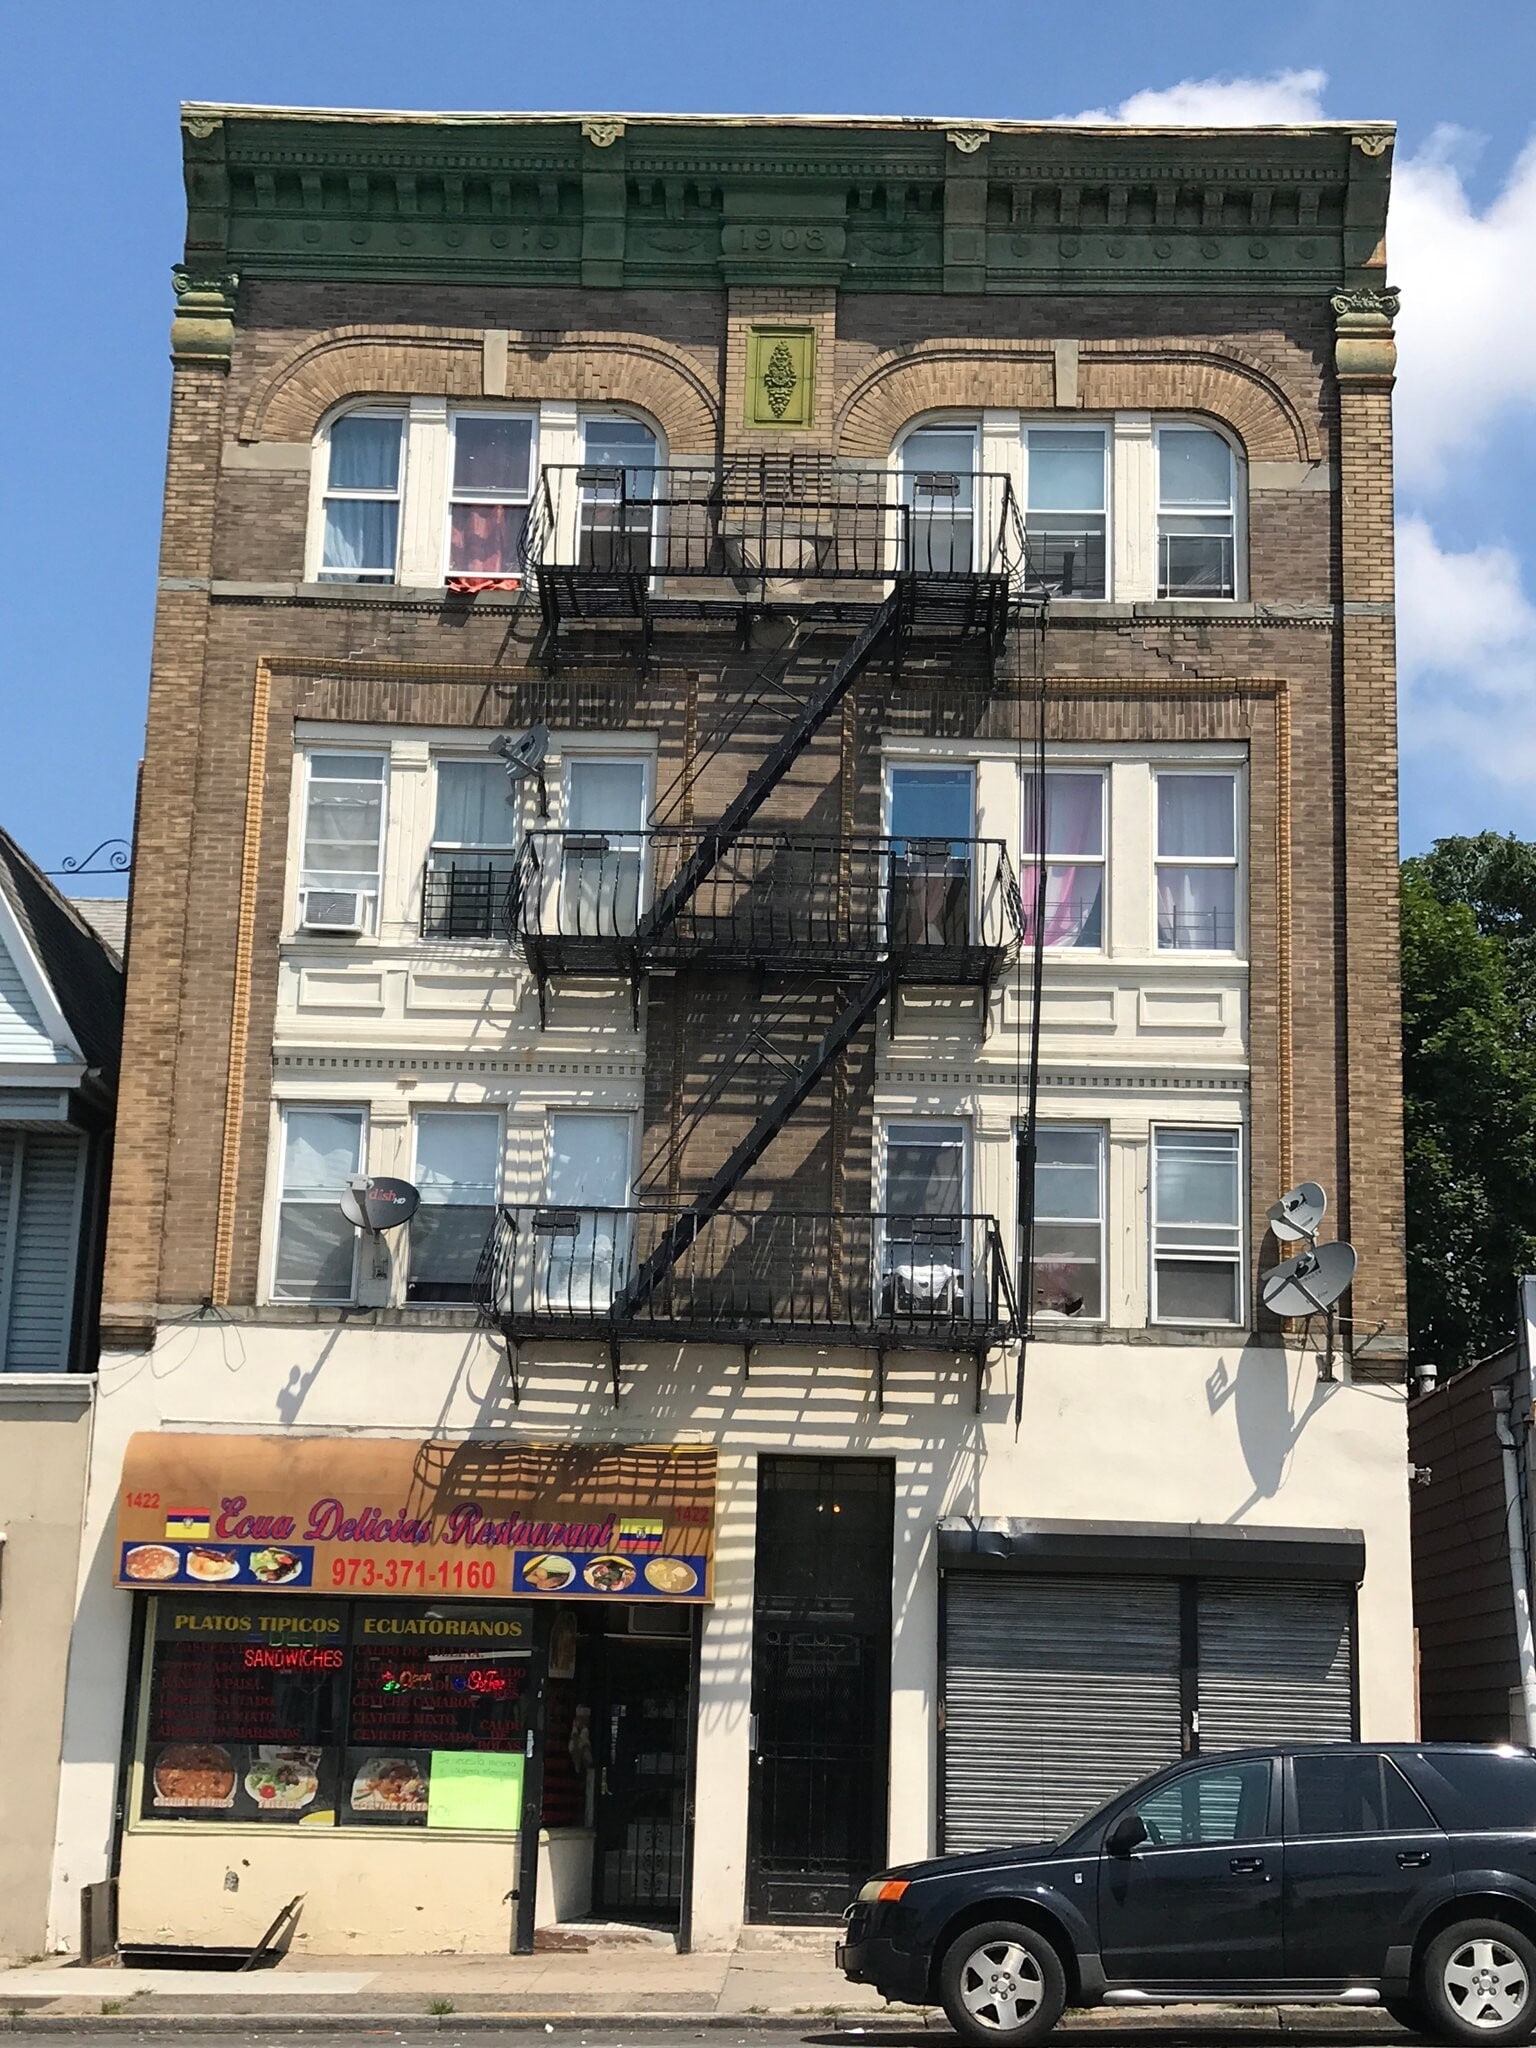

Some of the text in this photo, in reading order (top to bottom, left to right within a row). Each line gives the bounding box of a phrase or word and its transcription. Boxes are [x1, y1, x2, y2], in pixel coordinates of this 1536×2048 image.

[738, 228, 827, 250] 1908
[369, 1188, 406, 1205] dish HD
[125, 1493, 161, 1509] 1422
[215, 1496, 617, 1548] Ecua Delicias Restaurant
[674, 1506, 709, 1522] 1422
[332, 1557, 496, 1589] 973-371-1160
[174, 1615, 341, 1633] PLATOS TIPICOS
[363, 1618, 523, 1637] ECUATORIANOS
[244, 1649, 344, 1668] SANDWICHES
